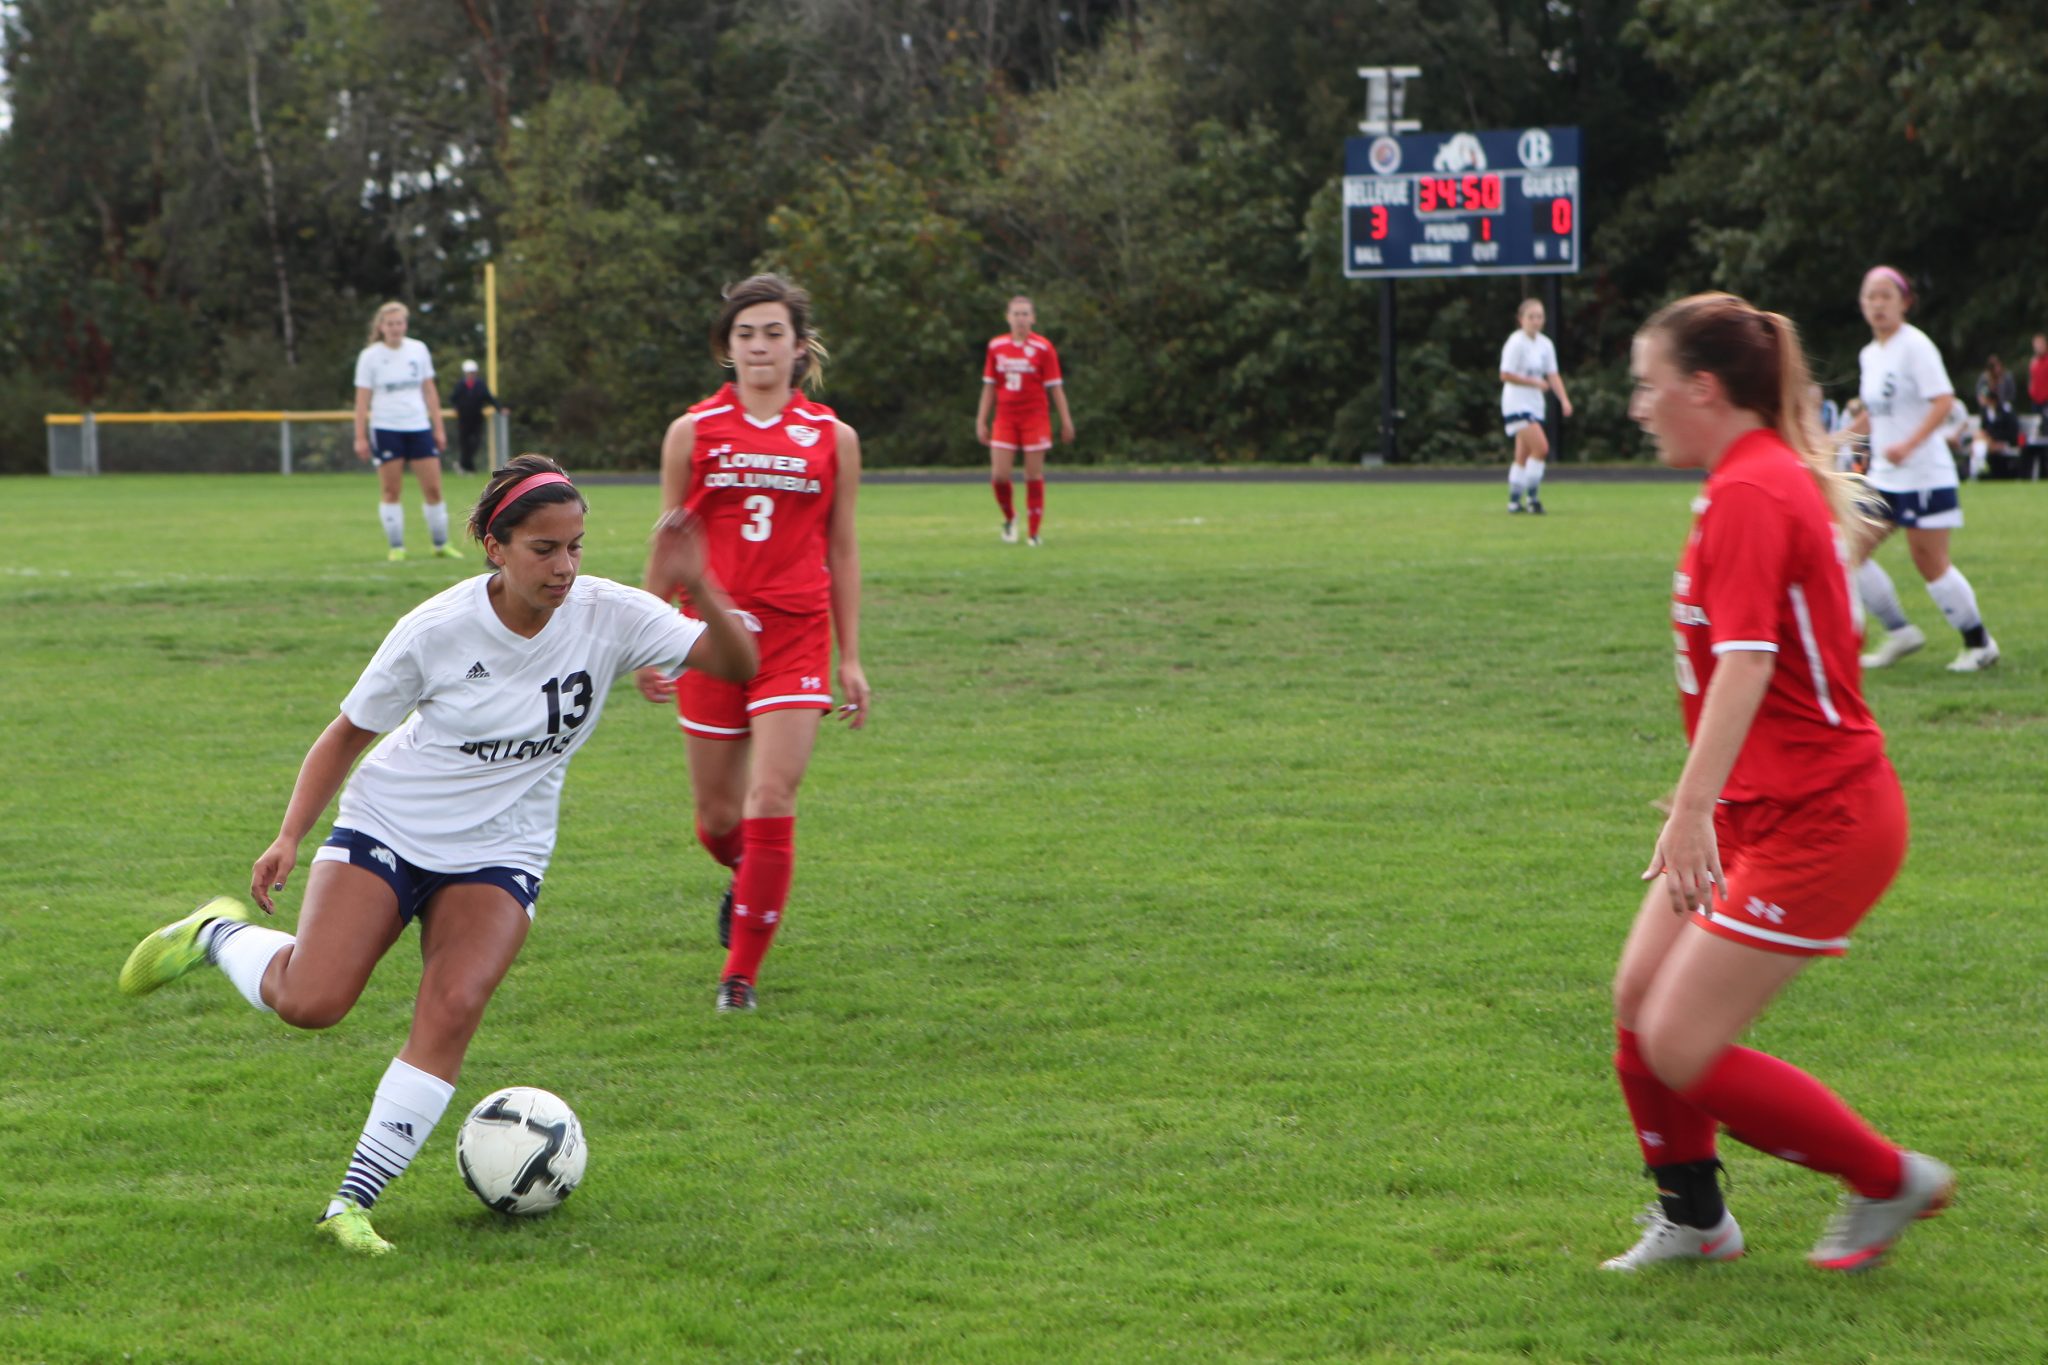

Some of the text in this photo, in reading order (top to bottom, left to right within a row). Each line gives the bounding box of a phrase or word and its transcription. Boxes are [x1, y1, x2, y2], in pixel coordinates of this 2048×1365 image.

[1521, 174, 1577, 197] GUEST
[1370, 205, 1388, 240] 3
[1552, 198, 1572, 234] 0
[1482, 217, 1491, 241] 1
[1472, 242, 1499, 261] OUT
[718, 453, 808, 473] LOWER
[704, 472, 822, 494] COLUMBIA
[740, 495, 775, 542] 3
[541, 670, 593, 735] 13
